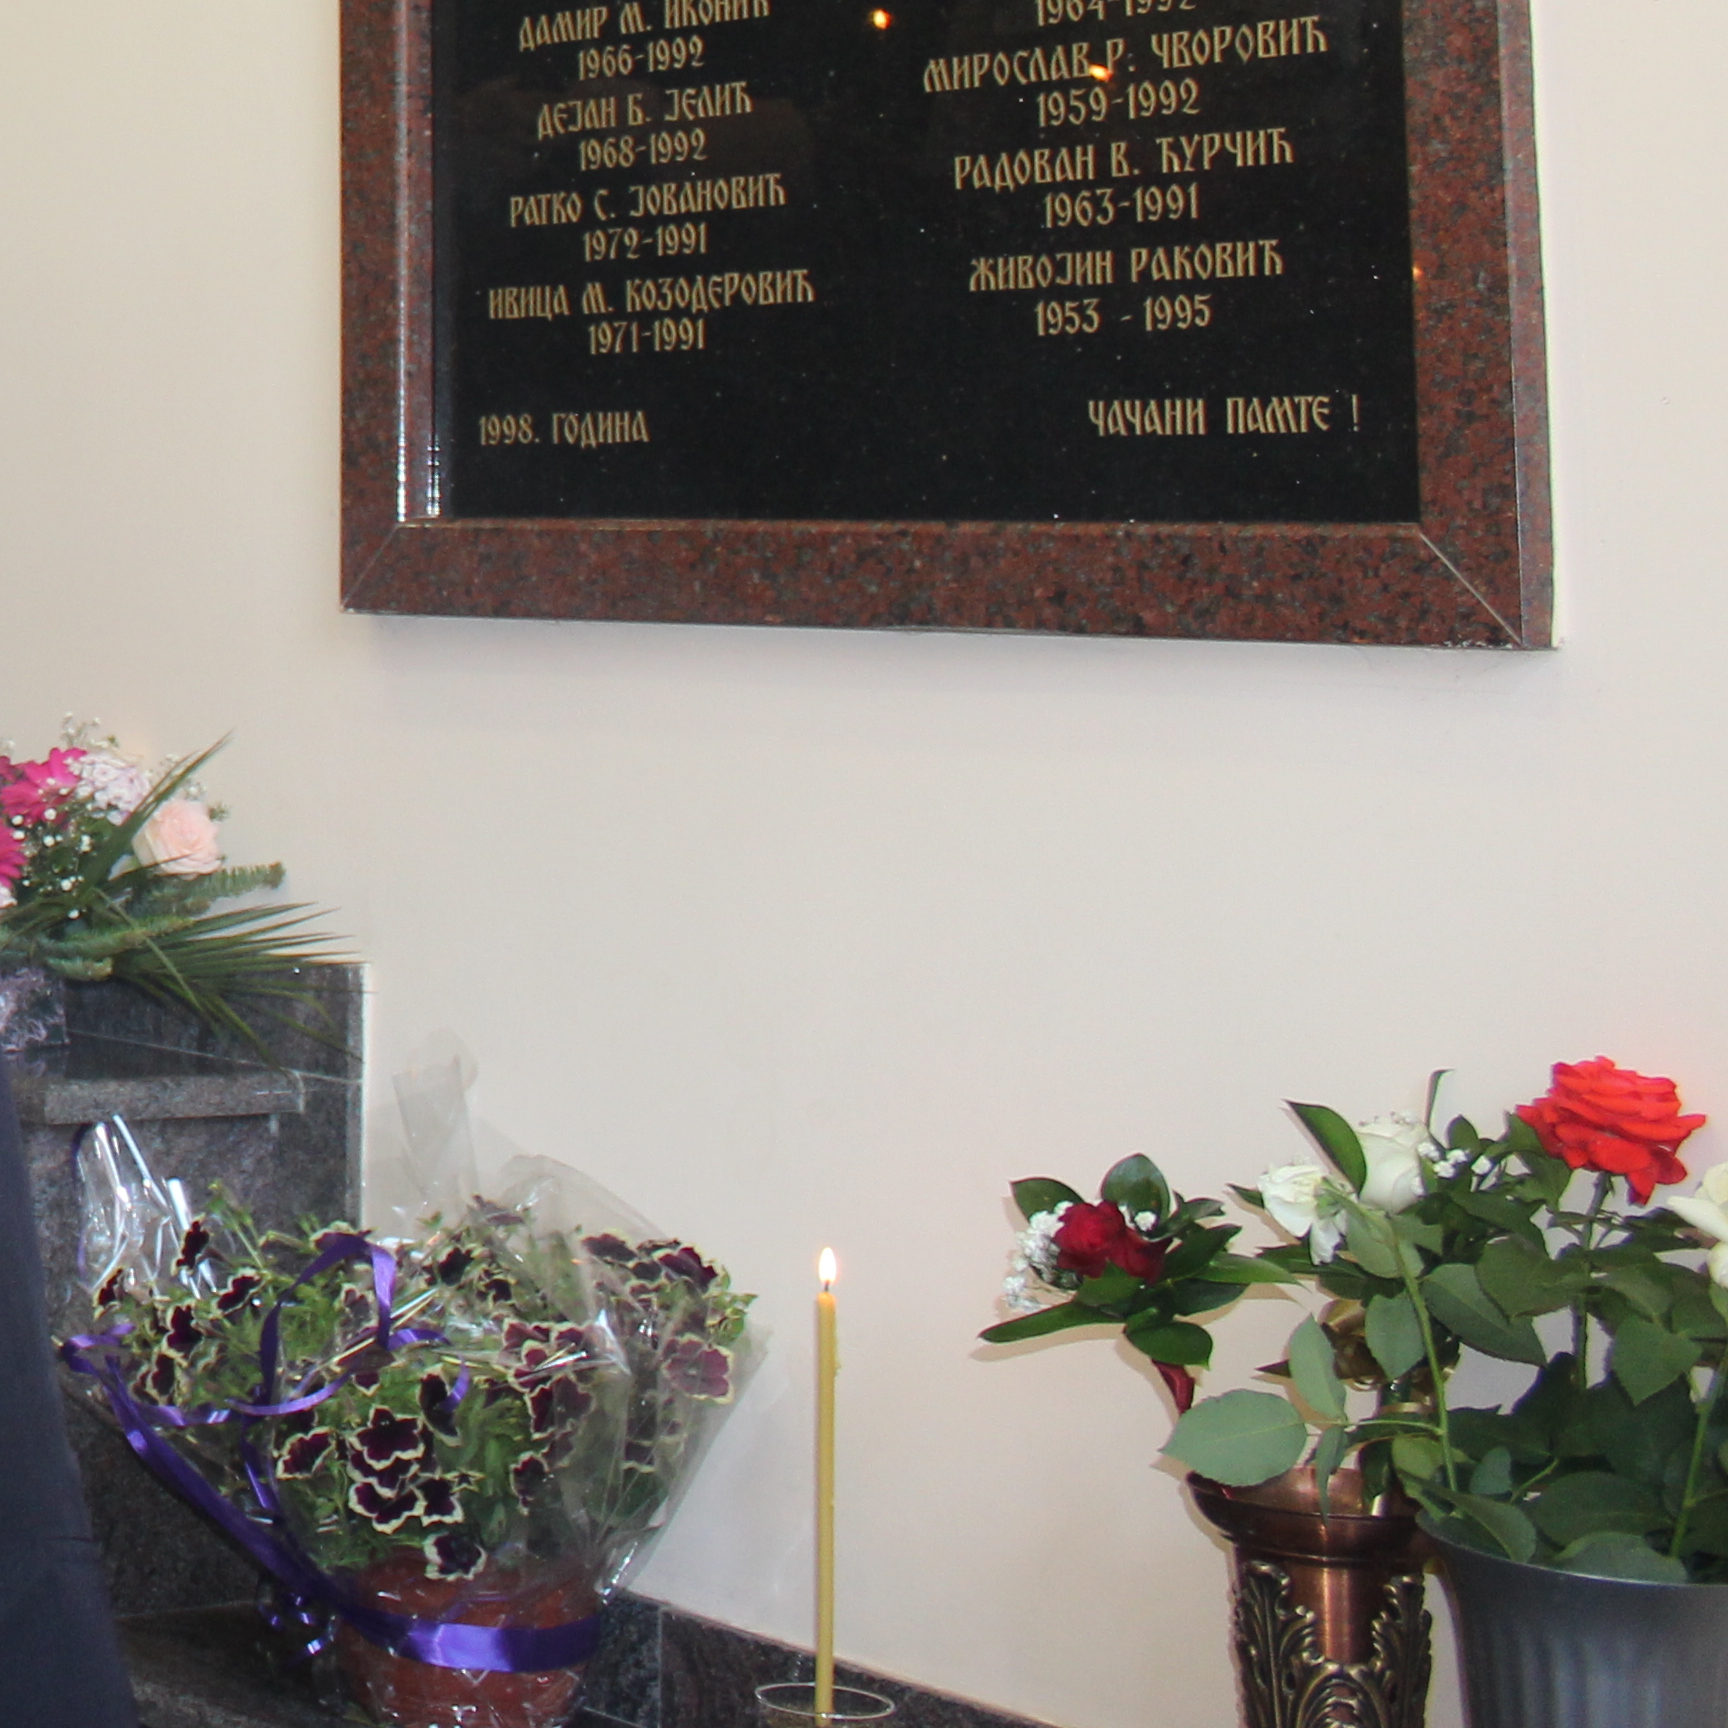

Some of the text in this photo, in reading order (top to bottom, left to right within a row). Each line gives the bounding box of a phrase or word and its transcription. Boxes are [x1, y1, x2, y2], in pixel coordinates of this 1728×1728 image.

[519, 7, 608, 52] ДАМИР
[620, 1, 652, 35] М.
[578, 36, 705, 80] 1966-1992
[924, 43, 1091, 92] МИРОСЛАВ
[1151, 15, 1328, 70] ЧВОРОВИЋ
[537, 82, 753, 141] ДЕЈАН Б. ЈЕЛИЋ
[1037, 78, 1202, 128] 1959-1992
[579, 128, 709, 171] 1968-1992
[954, 128, 1294, 193] РАДОВАН В. ЋУРЧИЋ
[510, 173, 787, 227] РАТКО С. ЈОВАНОВИЋ
[1044, 183, 1200, 229] 1963-1991
[584, 223, 709, 262] 1972-1991
[969, 239, 1284, 292] ЖИВОЈИН РАКОВИЋ
[489, 269, 816, 321] ИВИЦА М. КОЗОДЕРОВИЋ
[1036, 299, 1100, 337] 1953
[1143, 294, 1214, 332] 1995
[590, 318, 706, 355] 1971-1991
[479, 410, 650, 449] 1998. ГОДИНА
[1088, 398, 1206, 436] ЧАЧАНИ
